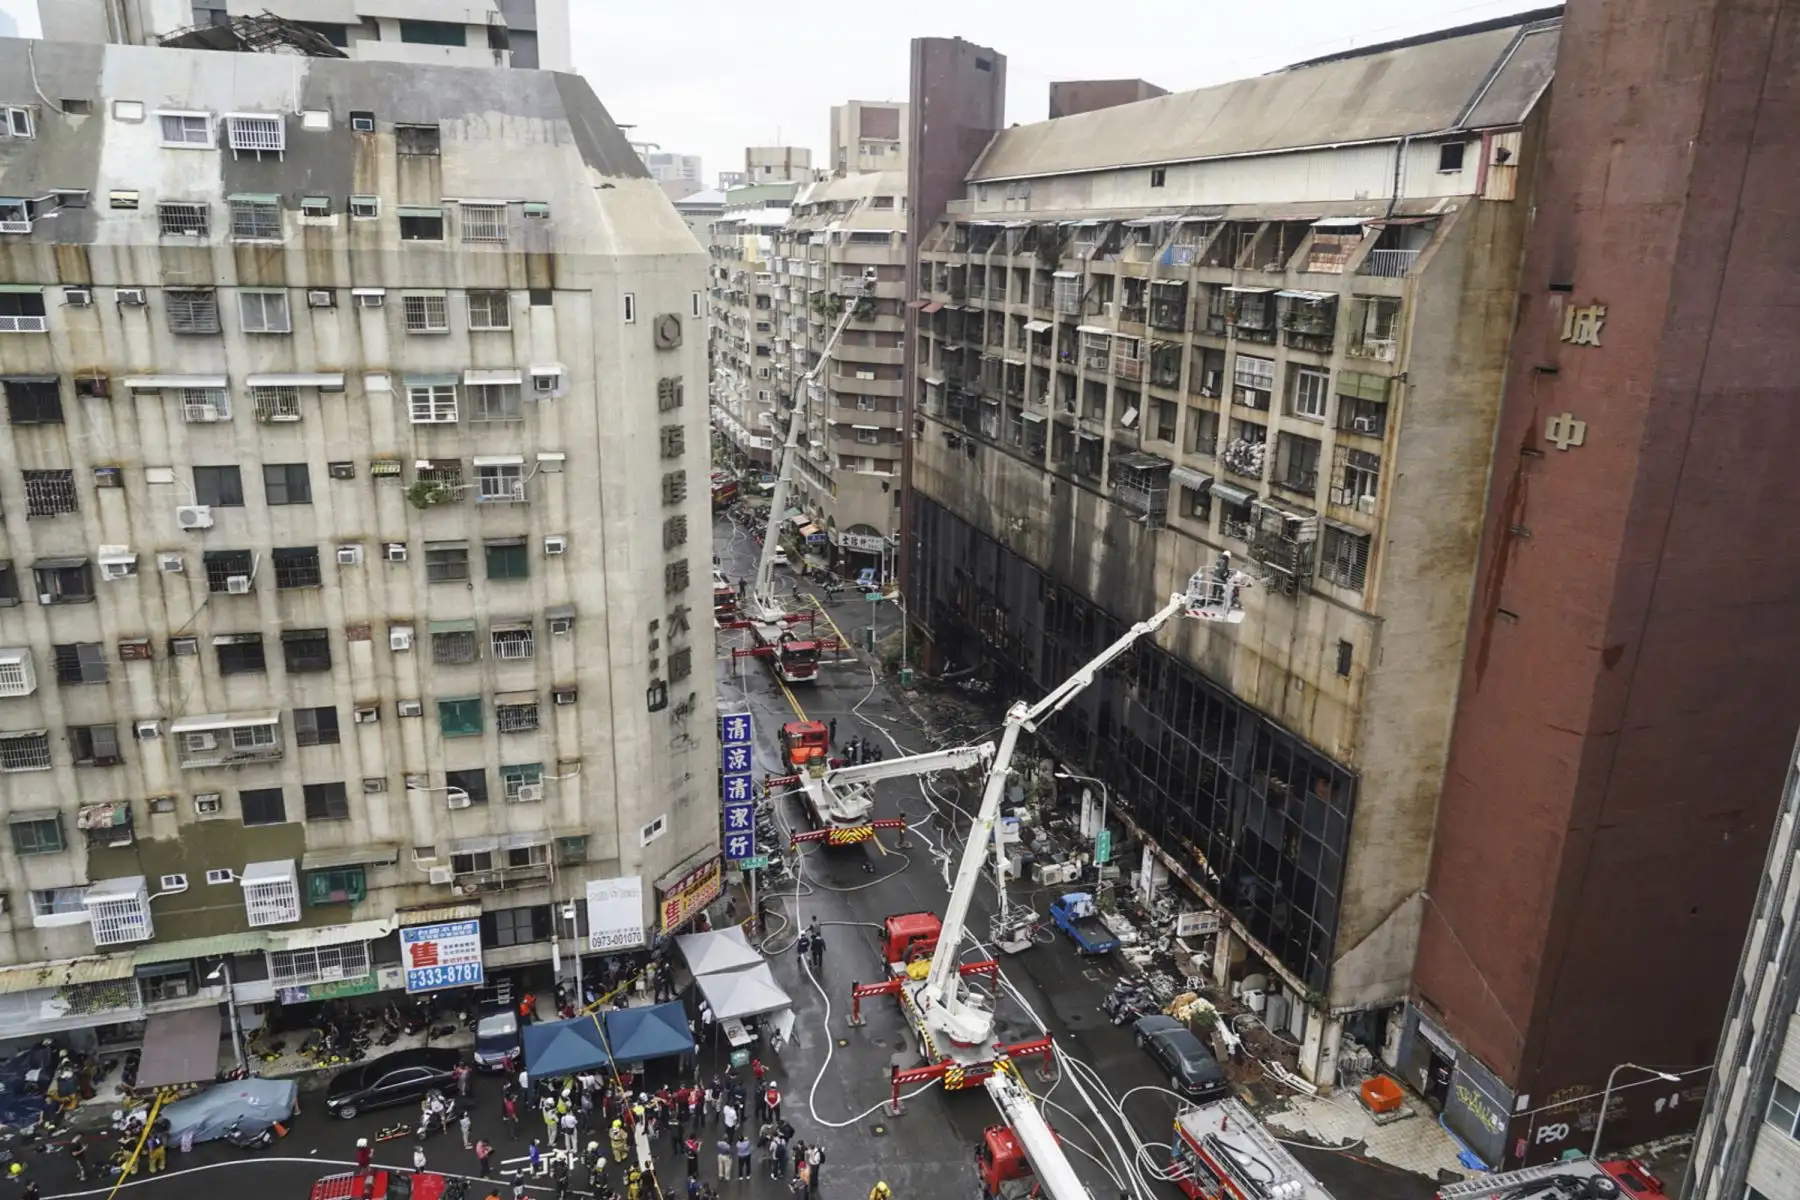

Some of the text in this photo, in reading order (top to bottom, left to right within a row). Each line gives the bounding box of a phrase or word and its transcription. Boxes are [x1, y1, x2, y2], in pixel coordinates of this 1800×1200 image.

[727, 718, 749, 856] 清涼清潔行
[592, 932, 642, 948] 0973-001070
[410, 942, 438, 968] 售
[418, 964, 479, 987] 333-8787
